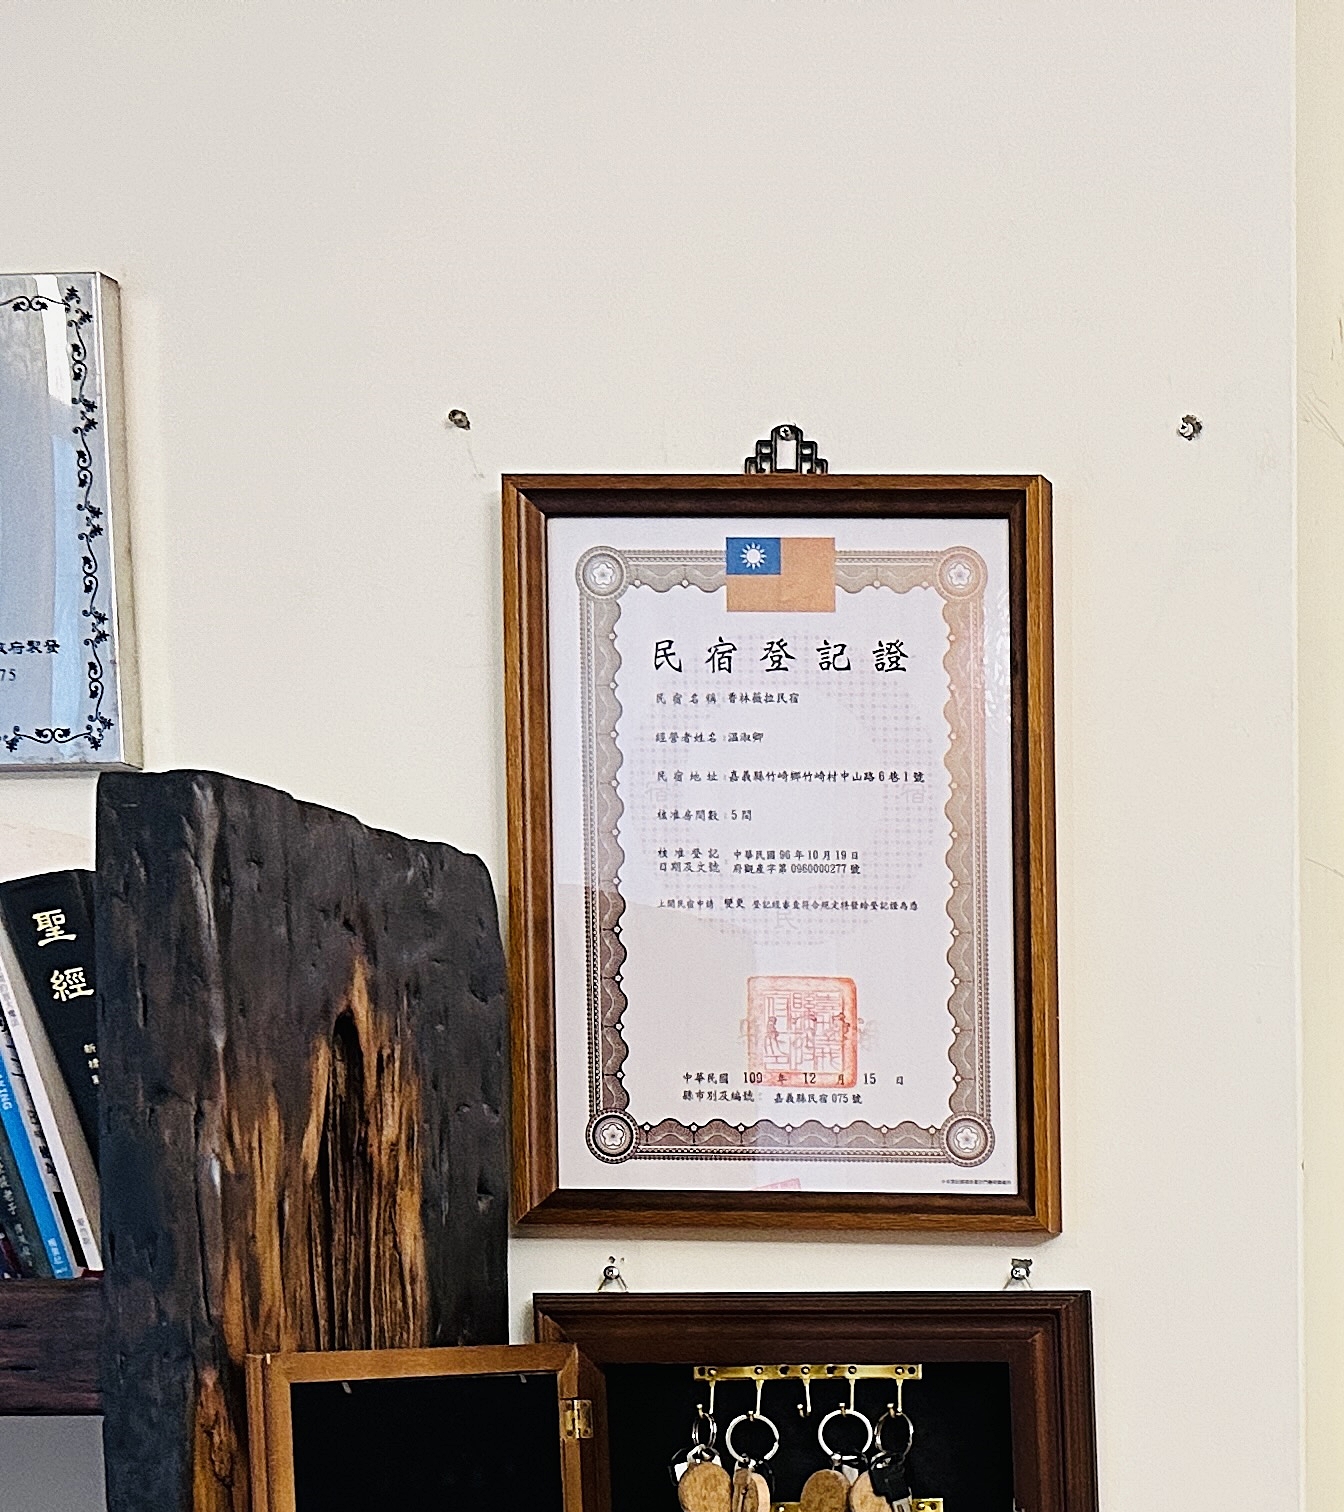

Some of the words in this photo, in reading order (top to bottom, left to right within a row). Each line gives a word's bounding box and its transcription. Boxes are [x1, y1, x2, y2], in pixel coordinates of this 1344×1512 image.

[653, 636, 910, 674] 民宿登記證
[32, 908, 95, 1001] 聖經
[863, 1072, 877, 1084] 15
